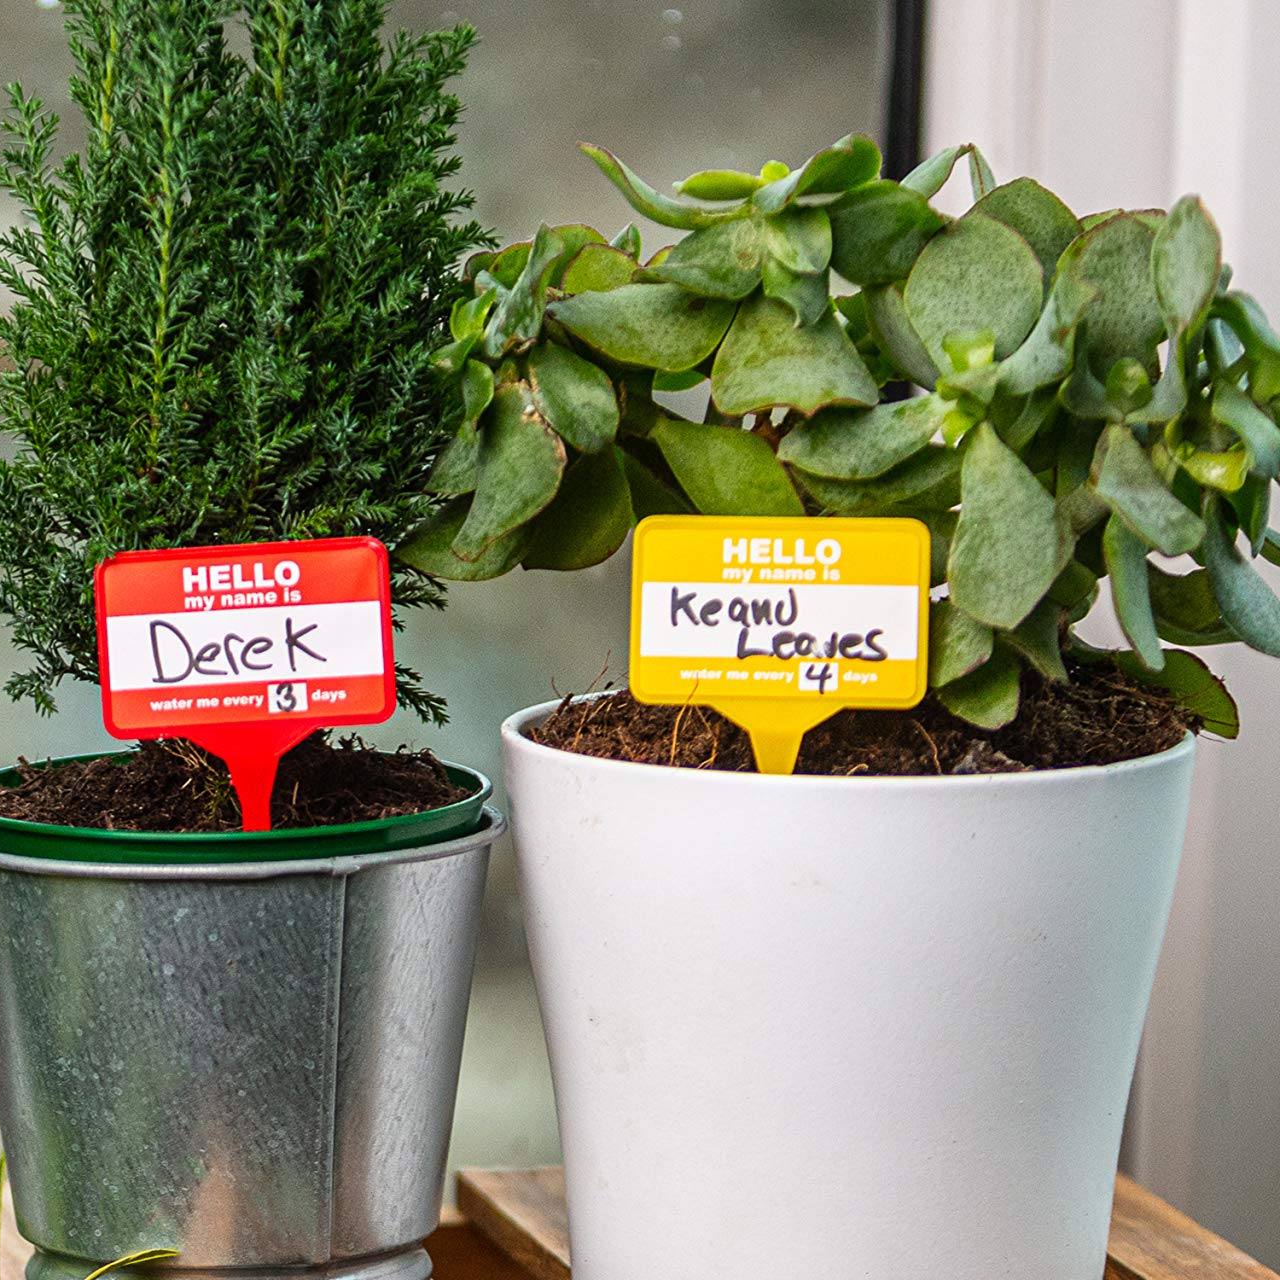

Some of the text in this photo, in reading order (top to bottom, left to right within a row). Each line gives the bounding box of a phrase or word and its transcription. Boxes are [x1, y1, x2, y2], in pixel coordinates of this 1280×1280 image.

[722, 538, 841, 564] HELLO
[182, 560, 300, 592] HELLO
[722, 565, 840, 582] my name is
[184, 587, 301, 610] my name is
[680, 663, 877, 694] water me every 4 days
[150, 681, 346, 712] water me every 3 days
